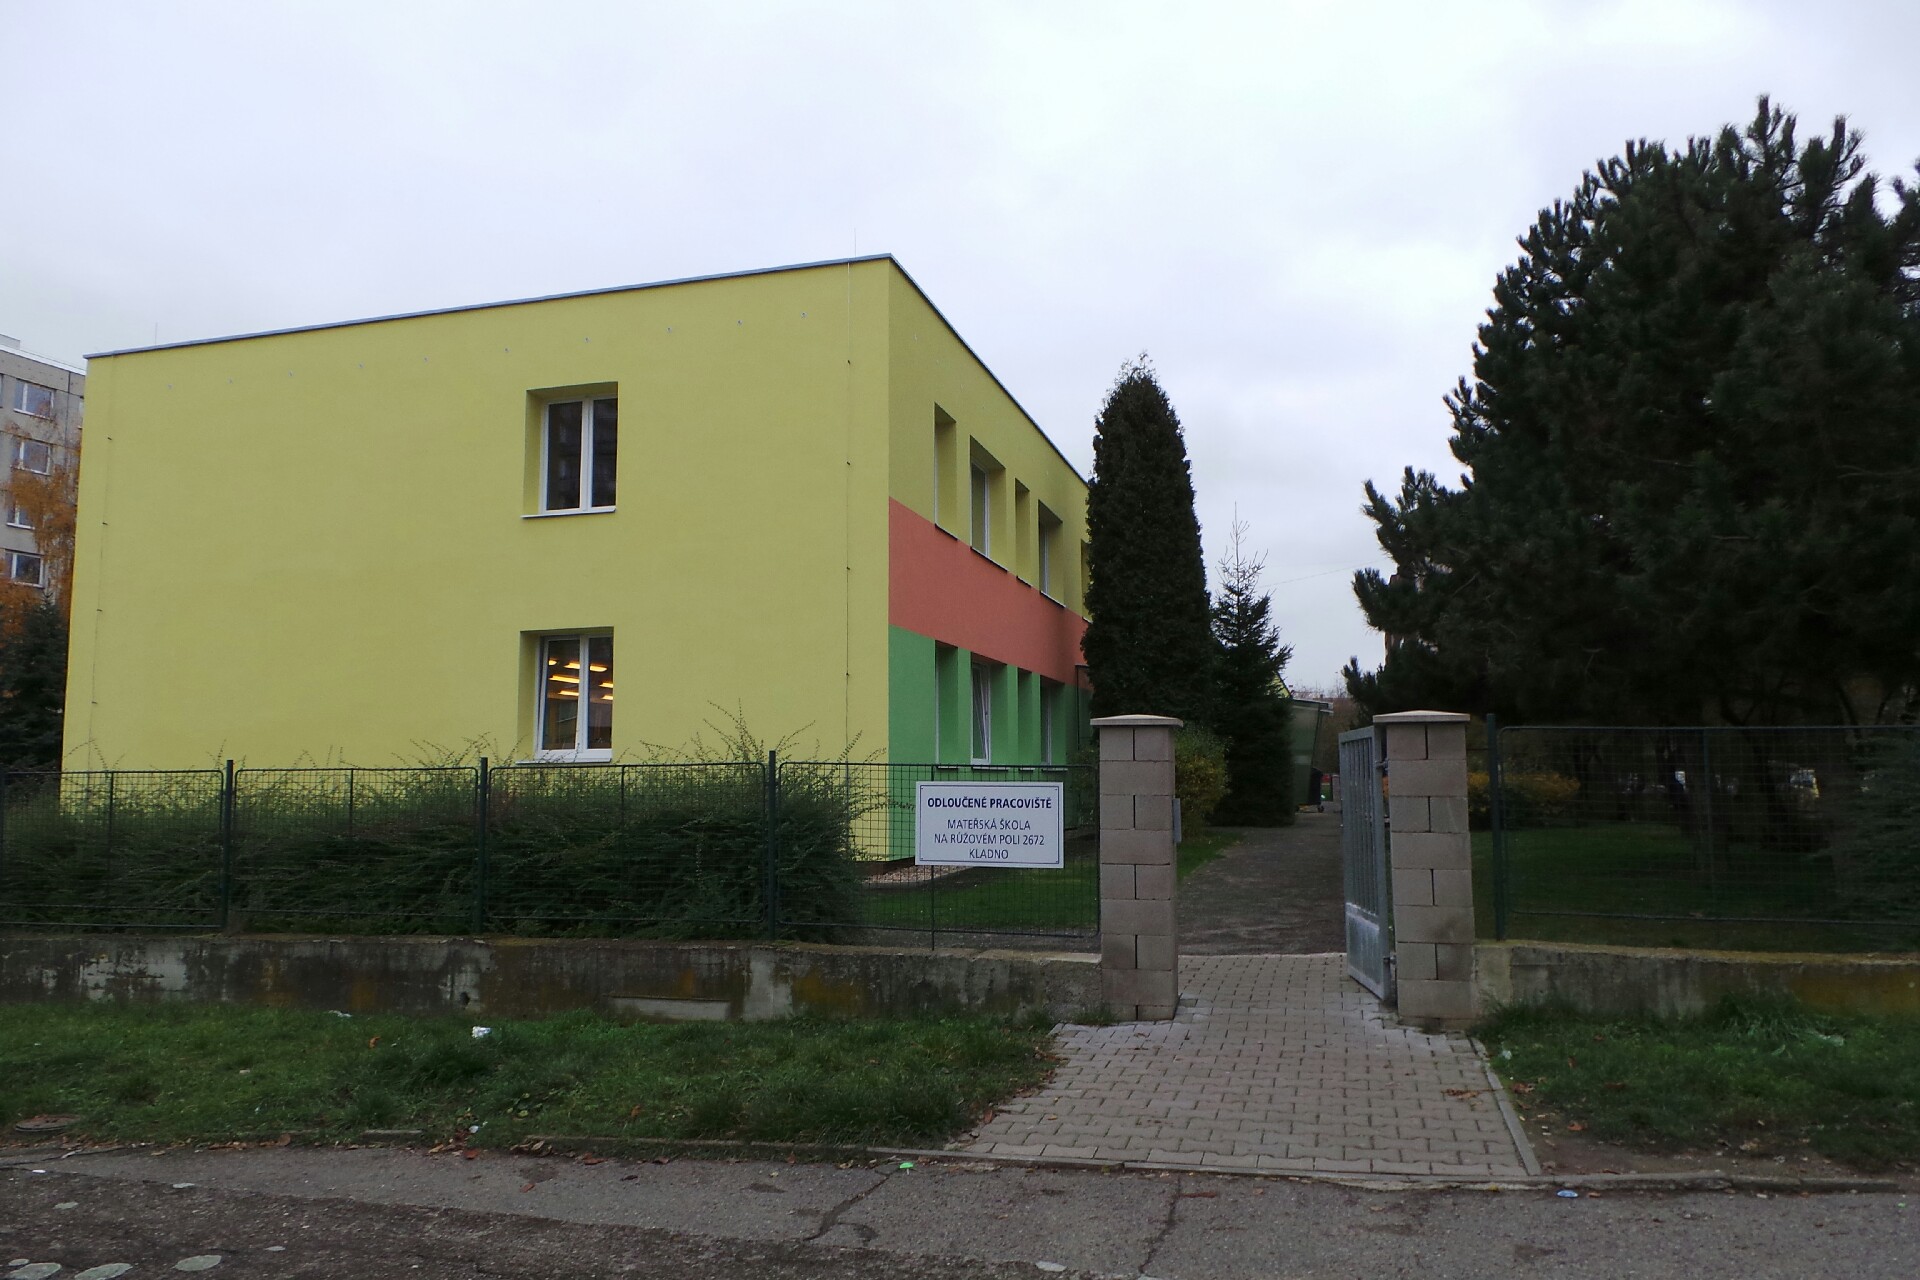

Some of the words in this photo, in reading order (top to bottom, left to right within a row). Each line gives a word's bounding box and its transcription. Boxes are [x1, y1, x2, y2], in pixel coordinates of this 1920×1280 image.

[927, 796, 987, 808] ODLOUČENÉ
[990, 797, 1052, 809] PRACOVIŠTĚ
[947, 818, 997, 830] MATEŘSKÁ
[1000, 819, 1031, 831] ŠKOLA
[934, 833, 948, 844] NA
[999, 834, 1020, 845] POLI
[1023, 835, 1045, 845] 2672
[969, 849, 1009, 859] KLADNO
